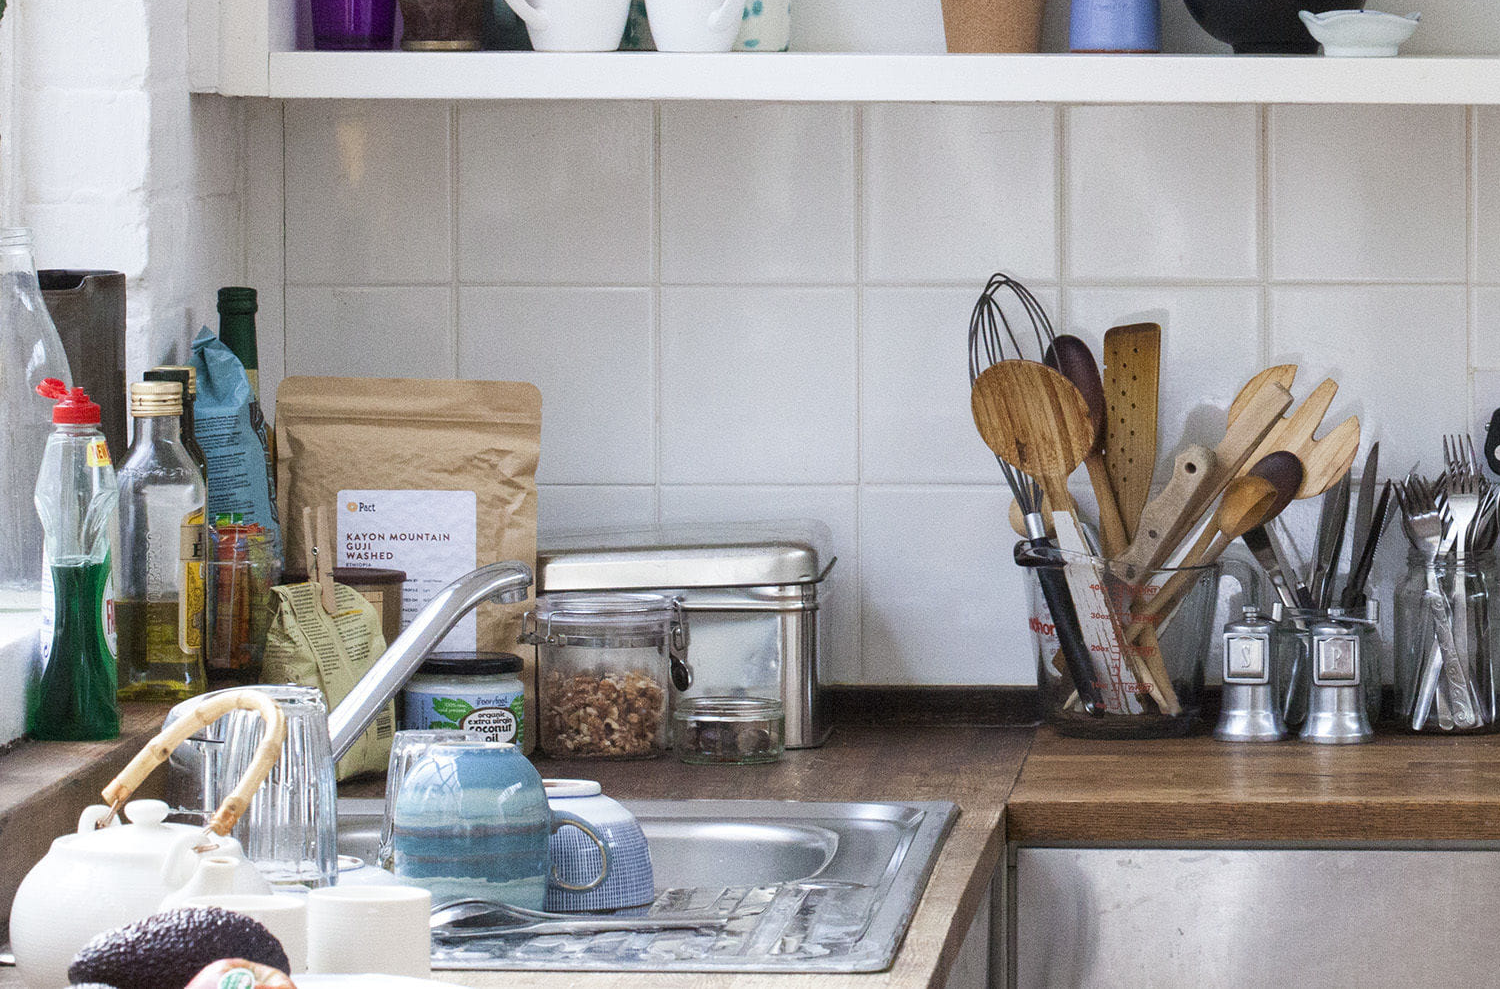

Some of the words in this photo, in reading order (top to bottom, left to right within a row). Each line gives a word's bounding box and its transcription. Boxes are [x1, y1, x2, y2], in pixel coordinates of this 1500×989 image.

[359, 502, 376, 512] Pact
[346, 533, 385, 541] KAYON
[389, 533, 450, 541] MOUNTAIN
[346, 543, 371, 551] GUJI
[346, 552, 394, 560] WASHED
[1090, 612, 1110, 620] 30oz
[1241, 645, 1251, 668] S
[1328, 646, 1342, 671] P
[478, 712, 506, 720] organic
[493, 716, 513, 724] virgin
[485, 734, 499, 742] oil
